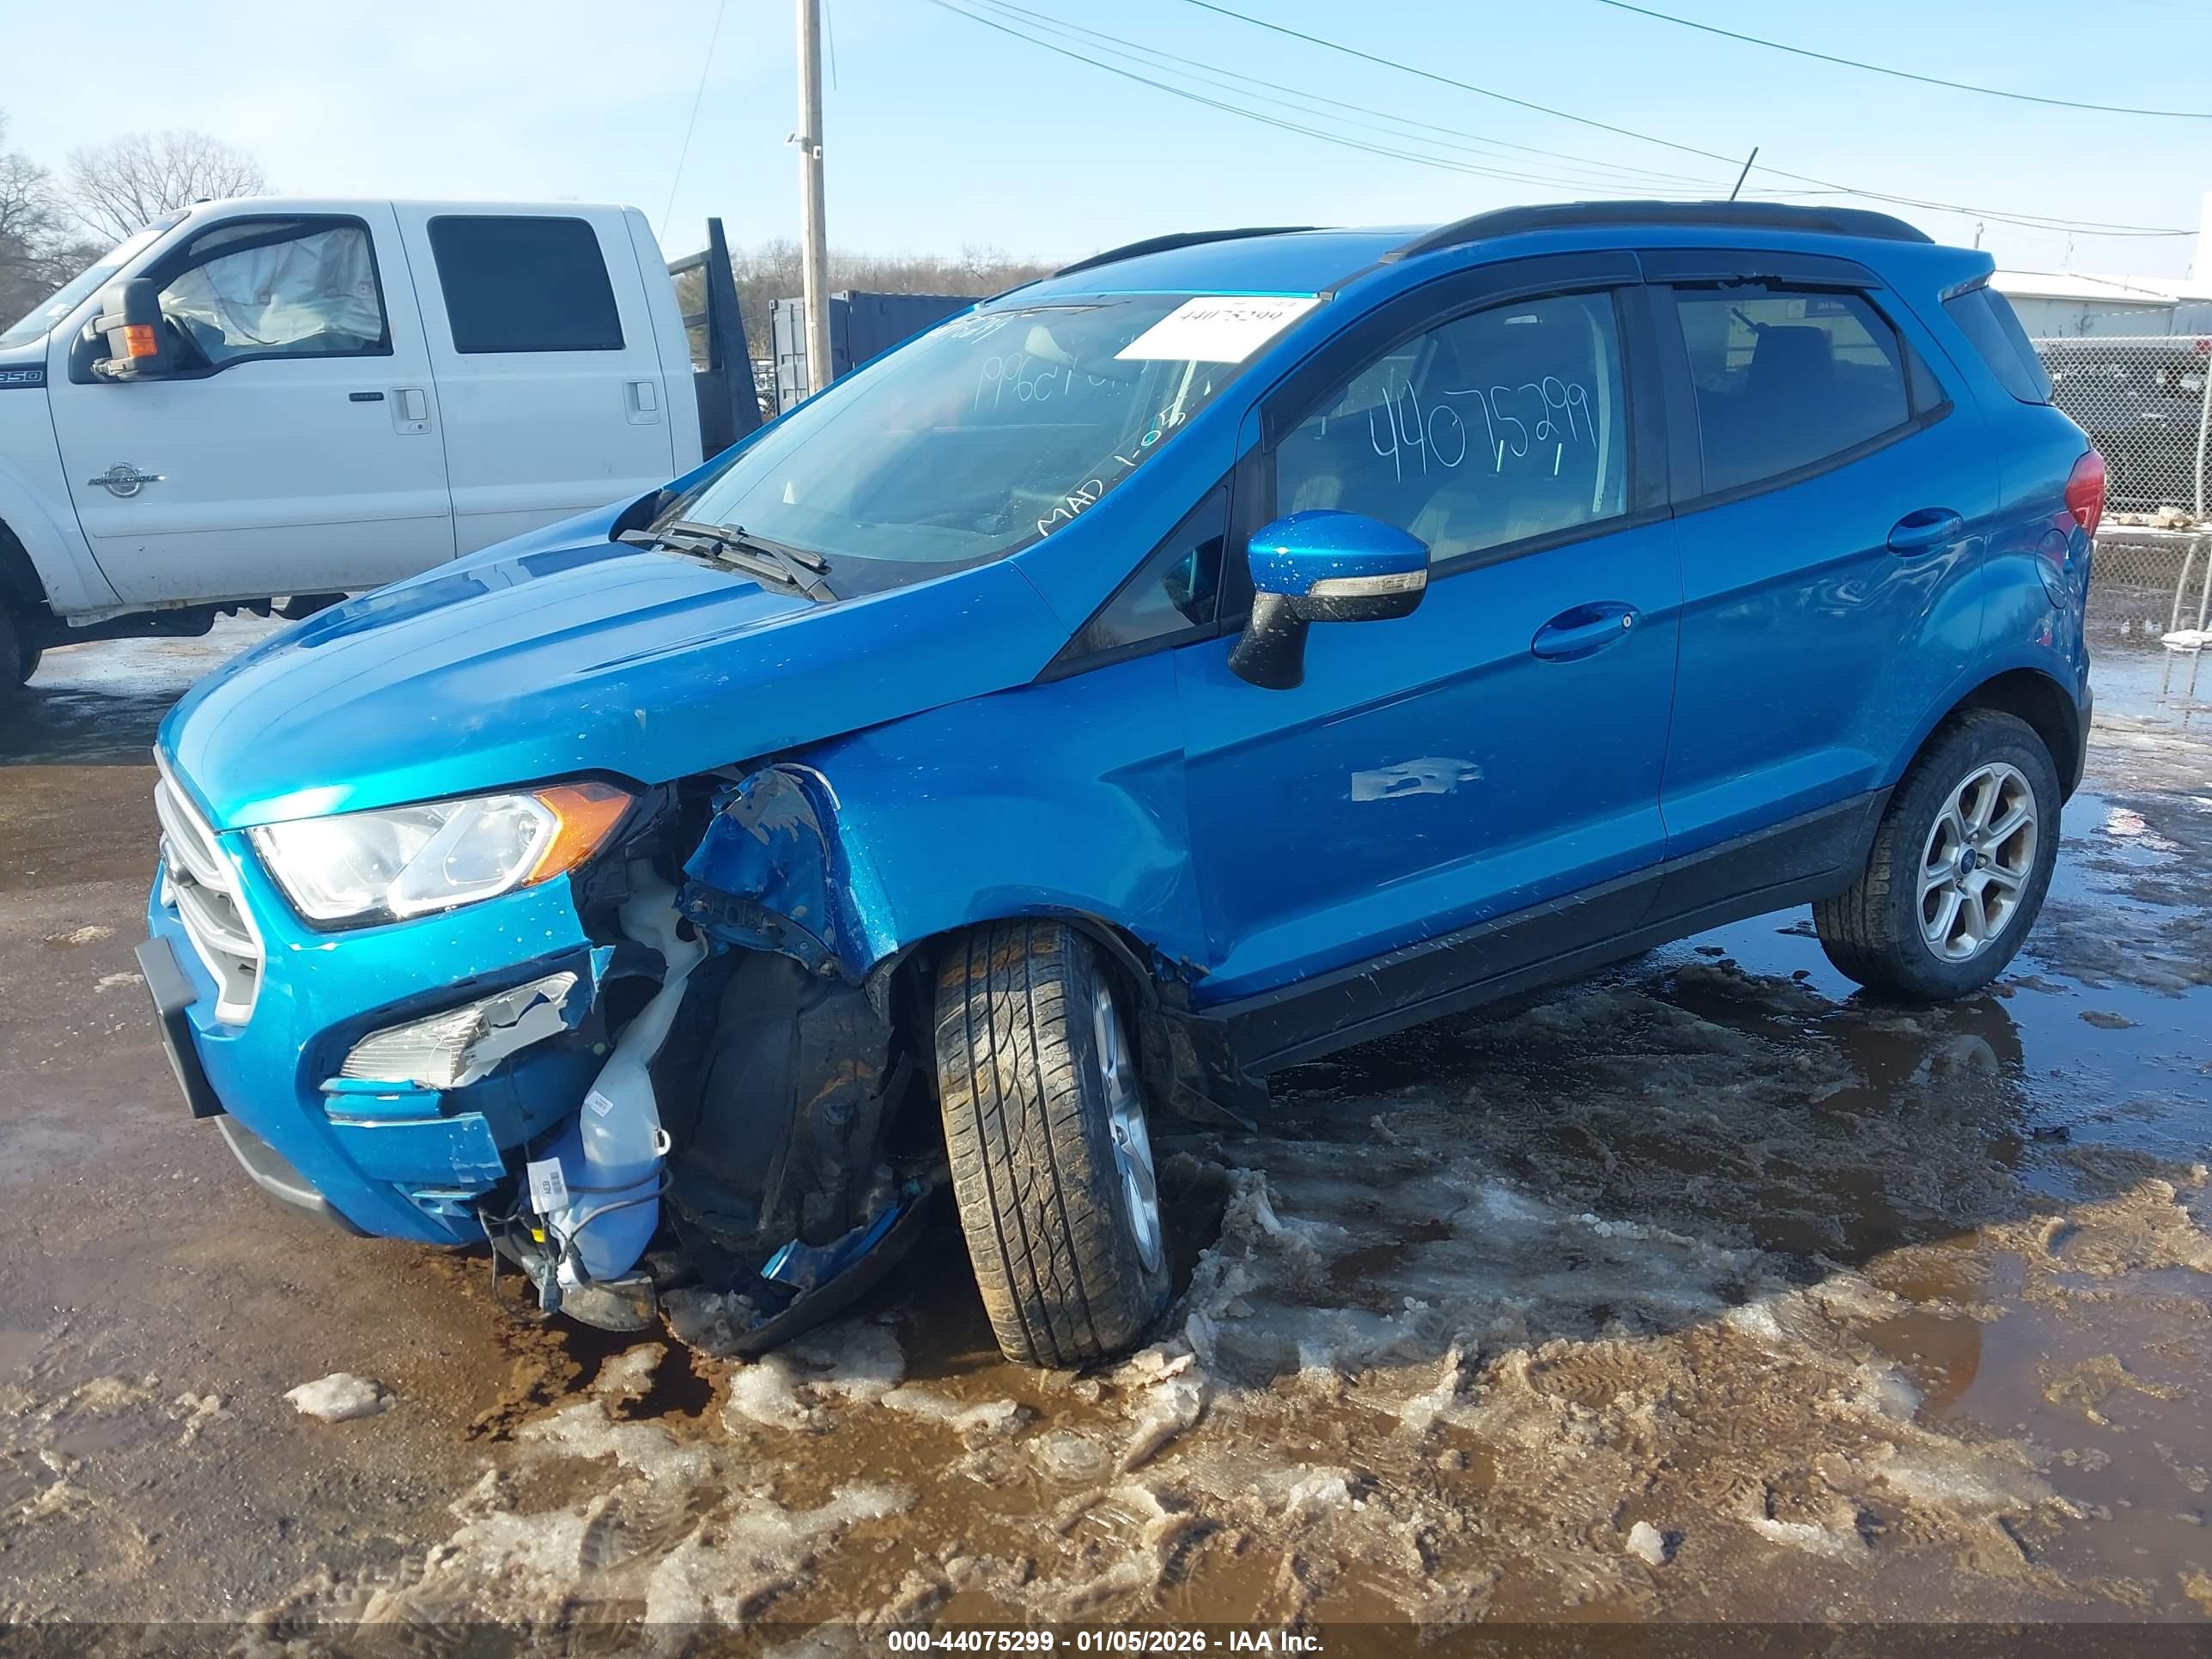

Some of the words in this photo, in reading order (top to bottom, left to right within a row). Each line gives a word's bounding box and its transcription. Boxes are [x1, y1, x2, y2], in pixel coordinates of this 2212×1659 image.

[1369, 376, 1596, 483] 44075299
[121, 475, 158, 483] STROKE
[1036, 478, 1104, 538] MAD
